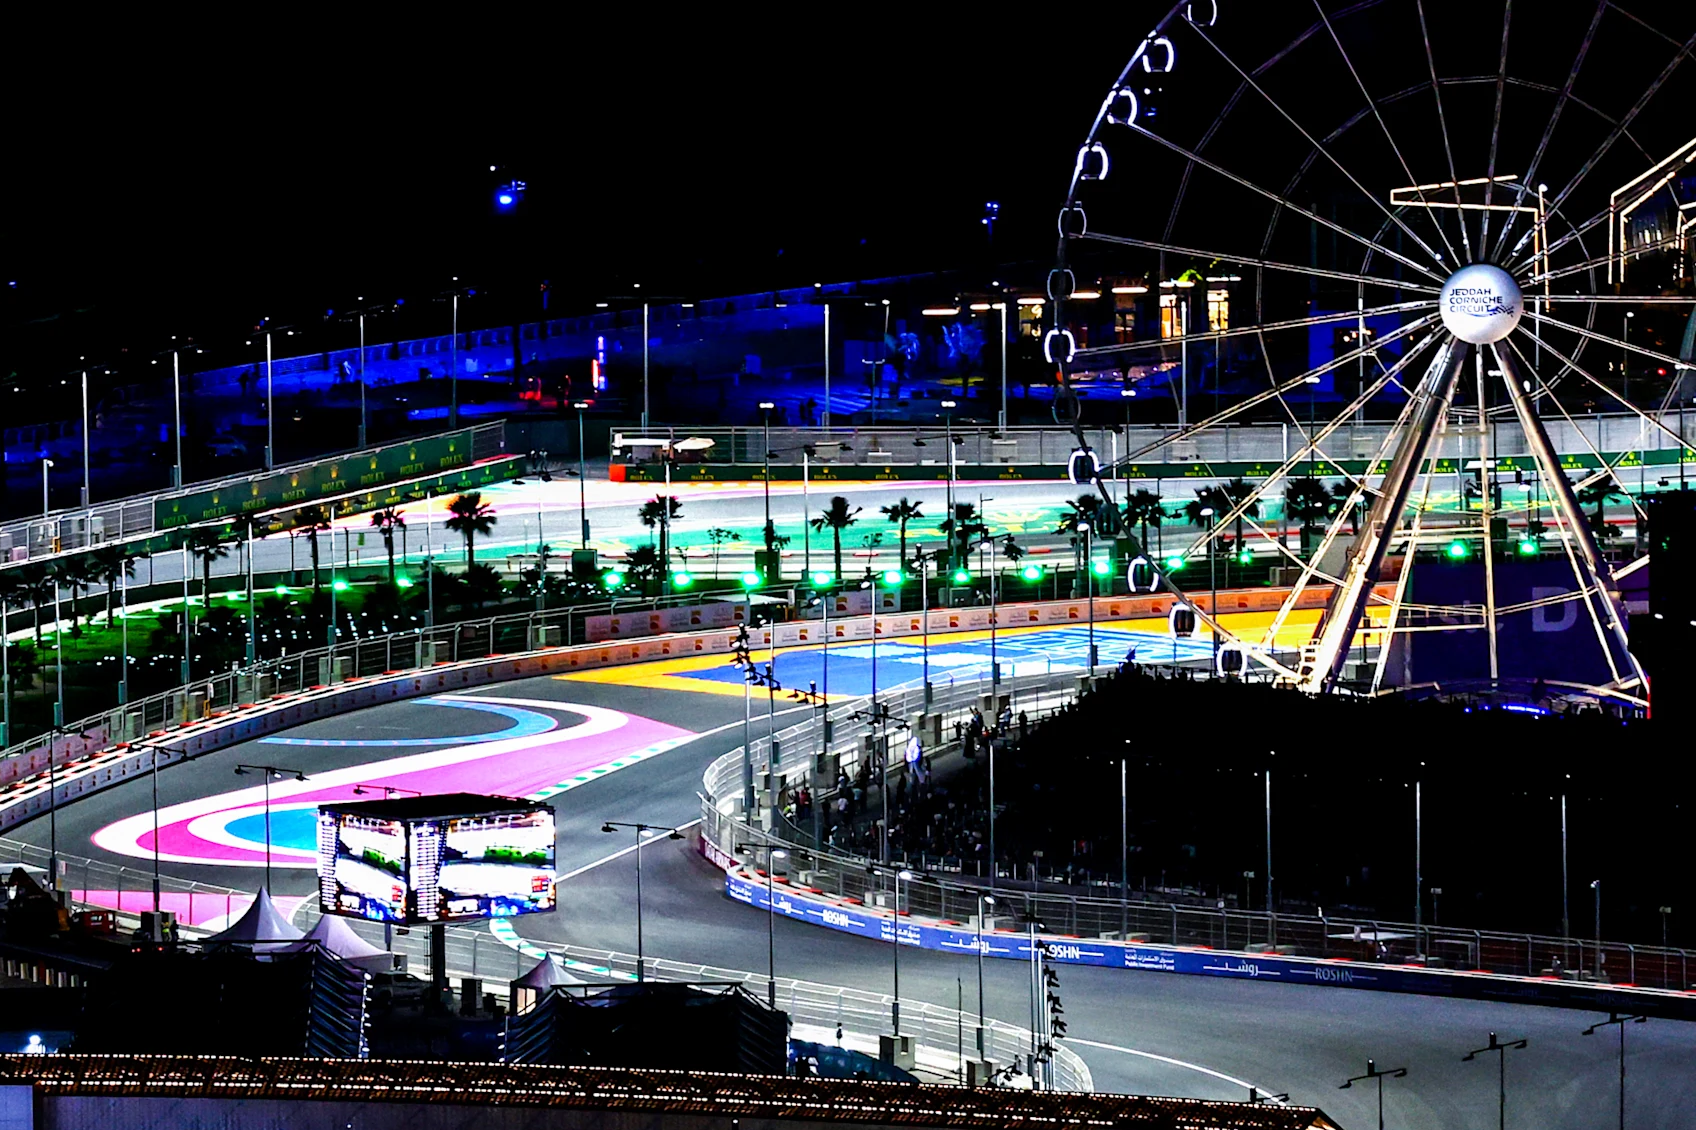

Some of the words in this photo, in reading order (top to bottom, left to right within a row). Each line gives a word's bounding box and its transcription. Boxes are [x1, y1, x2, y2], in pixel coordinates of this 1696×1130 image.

[1449, 288, 1491, 296] JEDDAH
[1449, 296, 1503, 304] CORNICHE
[1449, 304, 1491, 313] CIRCUIT
[1316, 967, 1353, 982] ROSHN
